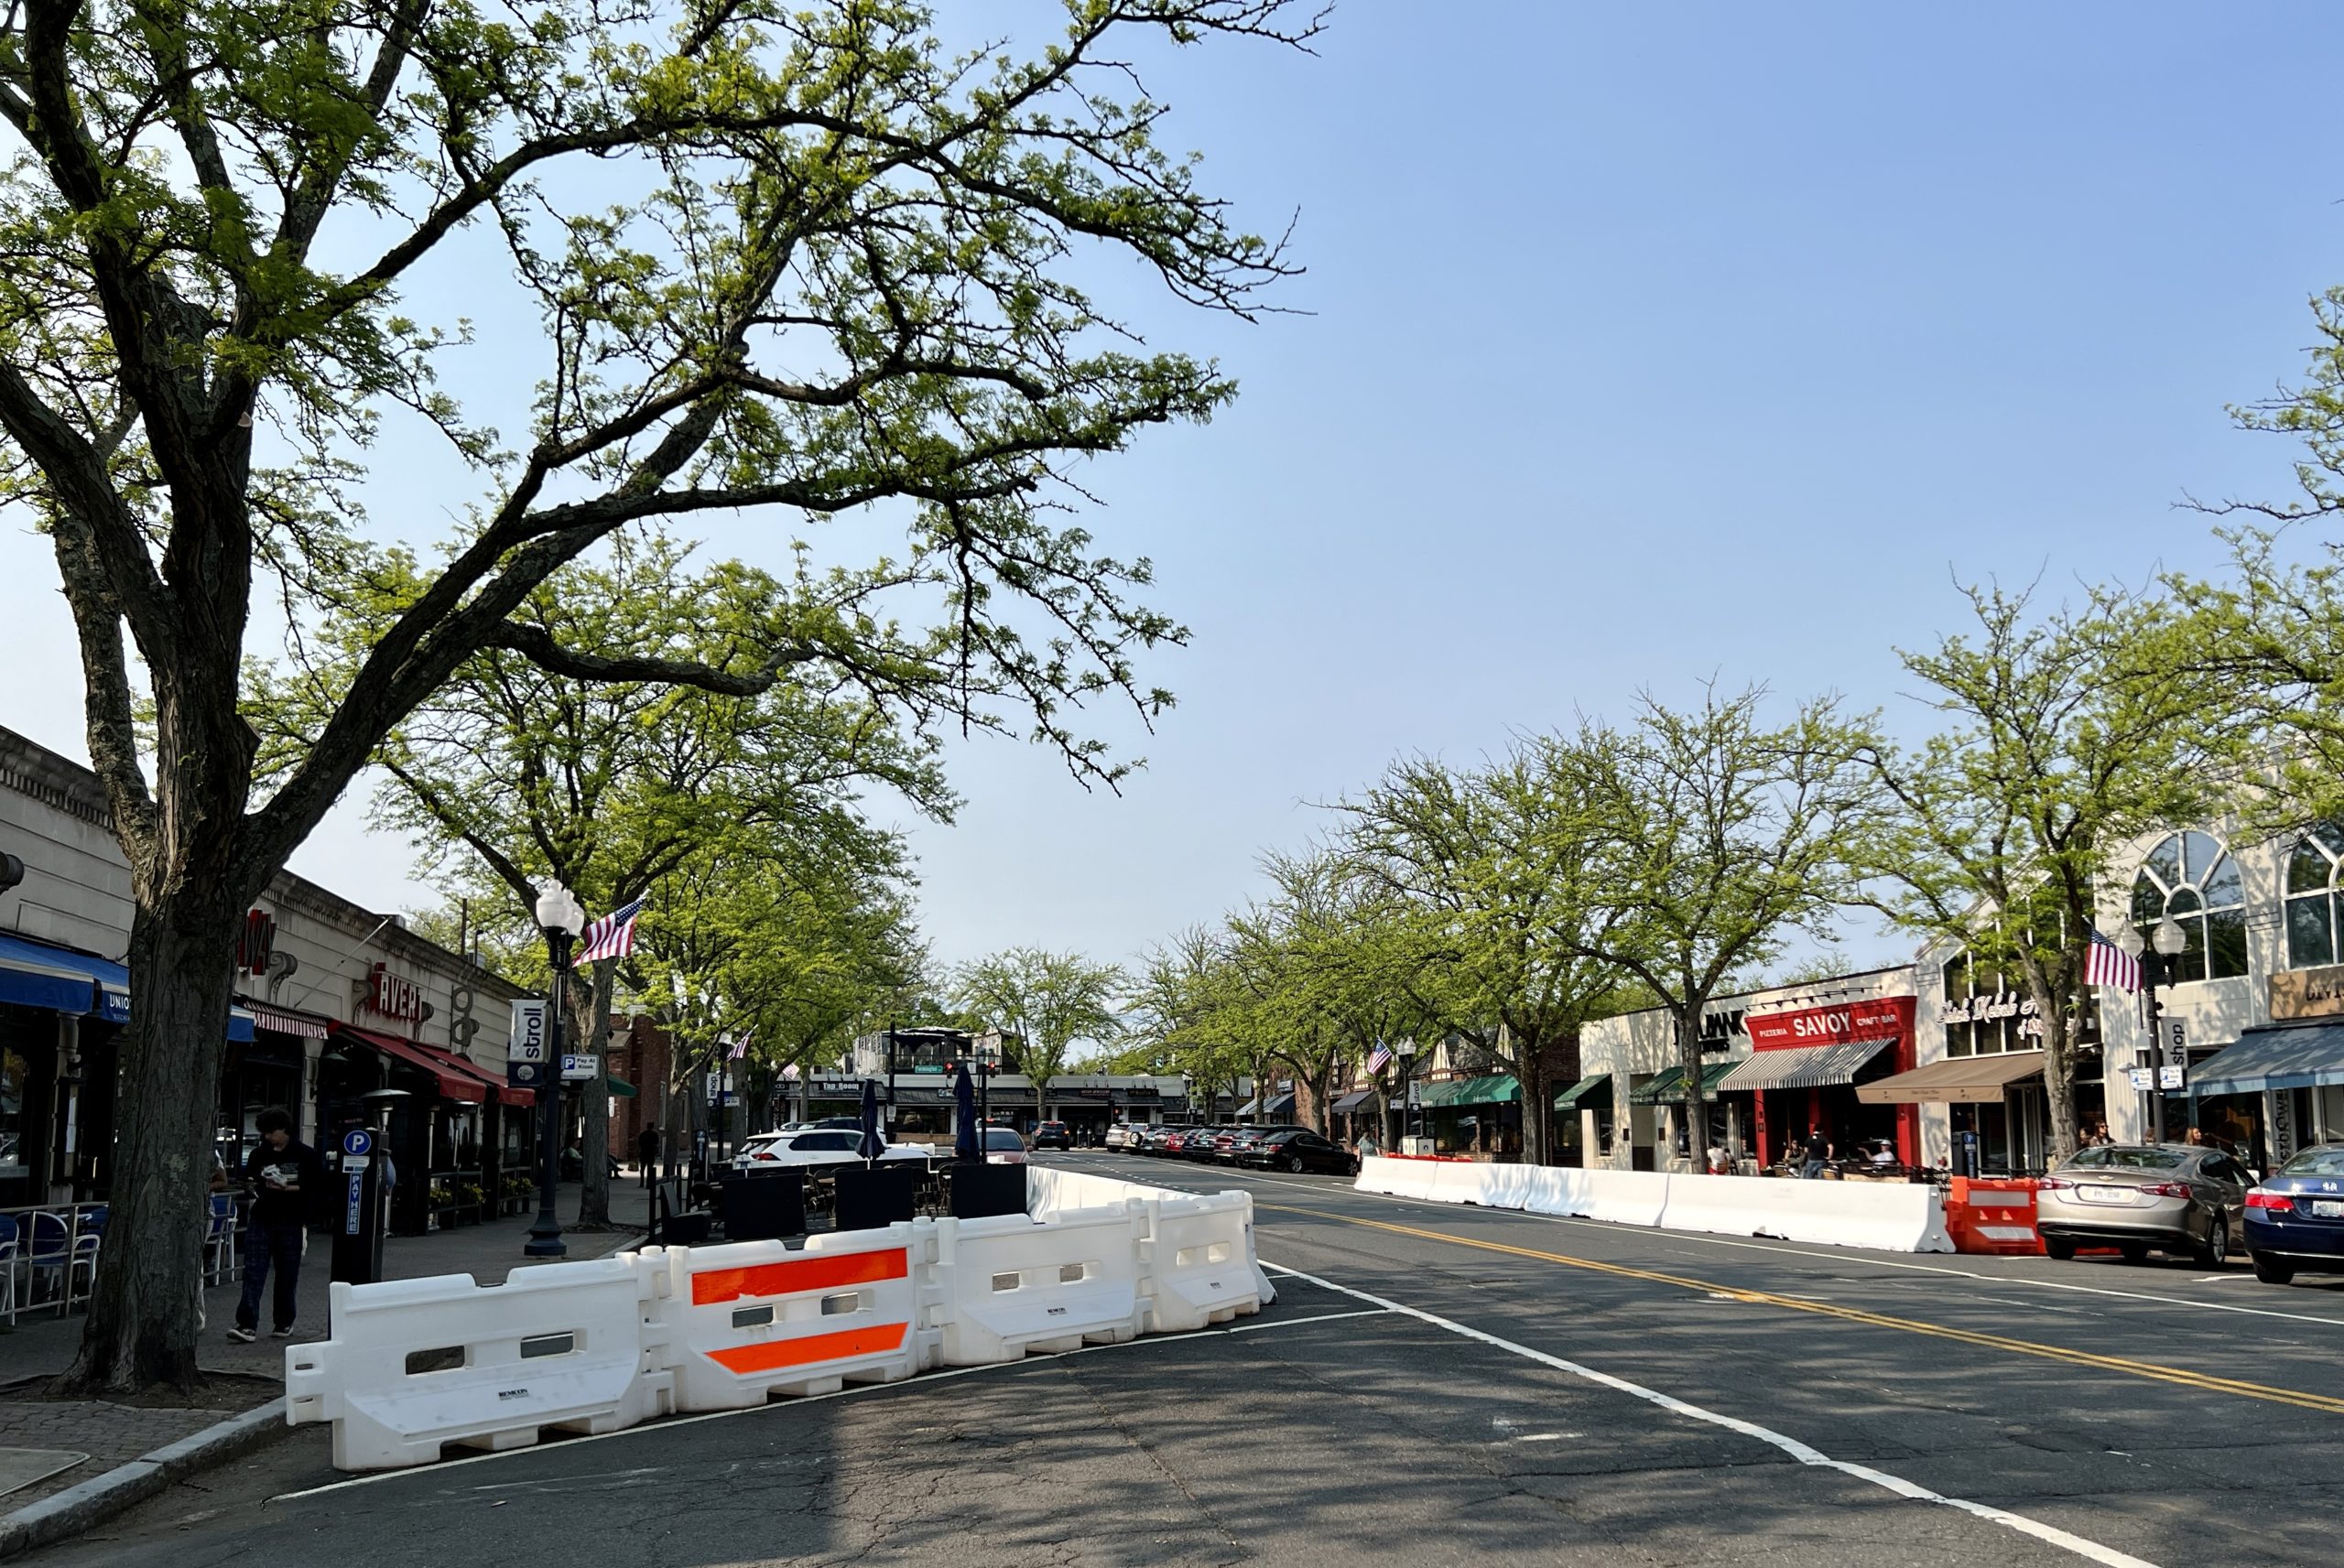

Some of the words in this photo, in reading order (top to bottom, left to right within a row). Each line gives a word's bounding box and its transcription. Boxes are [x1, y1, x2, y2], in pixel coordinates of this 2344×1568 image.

[108, 993, 131, 1011] UNIO
[523, 1007, 542, 1059] stroll
[1706, 1010, 1748, 1036] BANK
[1759, 1028, 1788, 1038] PIZZERIA
[1793, 1011, 1850, 1037] SAVOY
[1856, 1015, 1879, 1026] CRAFT
[1881, 1013, 1897, 1023] BAR
[2170, 1023, 2186, 1065] shop
[352, 1134, 364, 1152] P
[352, 1175, 360, 1198] PAY
[349, 1201, 359, 1231] HERE
